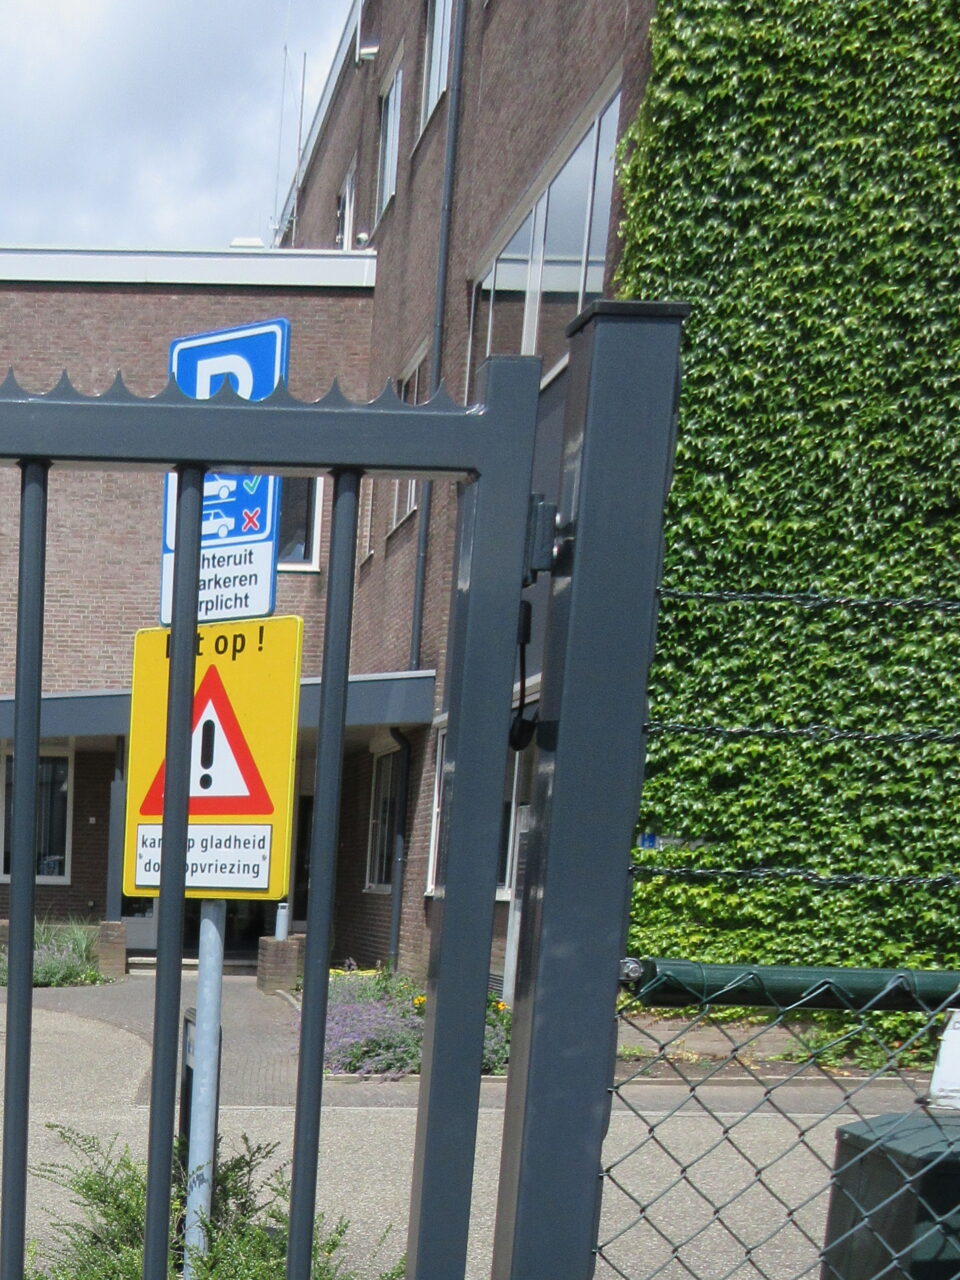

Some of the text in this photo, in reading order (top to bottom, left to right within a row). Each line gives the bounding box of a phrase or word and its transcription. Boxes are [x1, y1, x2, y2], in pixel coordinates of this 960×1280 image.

[201, 548, 254, 570] hteruit
[198, 573, 258, 591] arkeren
[198, 592, 250, 616] rplicht
[214, 633, 246, 661] op
[200, 834, 267, 853] gladheid
